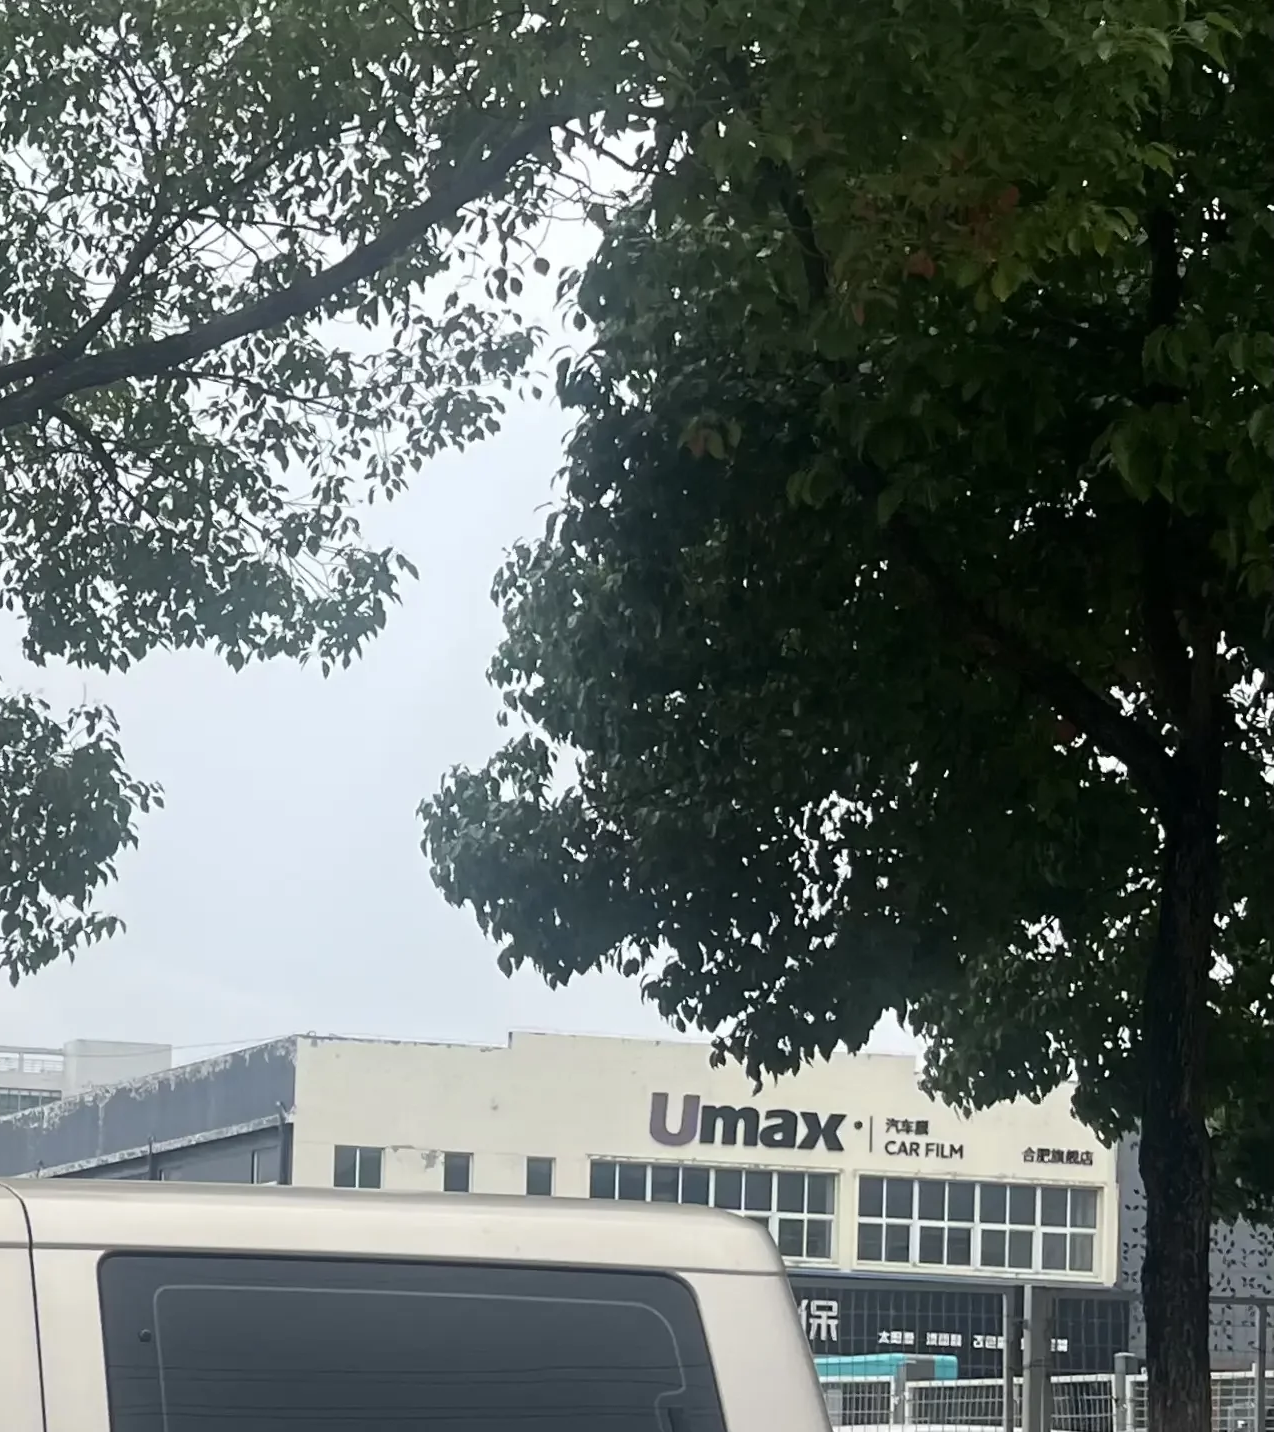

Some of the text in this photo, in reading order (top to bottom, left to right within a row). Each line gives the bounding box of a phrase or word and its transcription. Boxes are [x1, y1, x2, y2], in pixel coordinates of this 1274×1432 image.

[649, 1091, 847, 1152] Umax
[884, 1140, 964, 1159] CAR FILM
[1021, 1146, 1094, 1167] 合肥旗舰店
